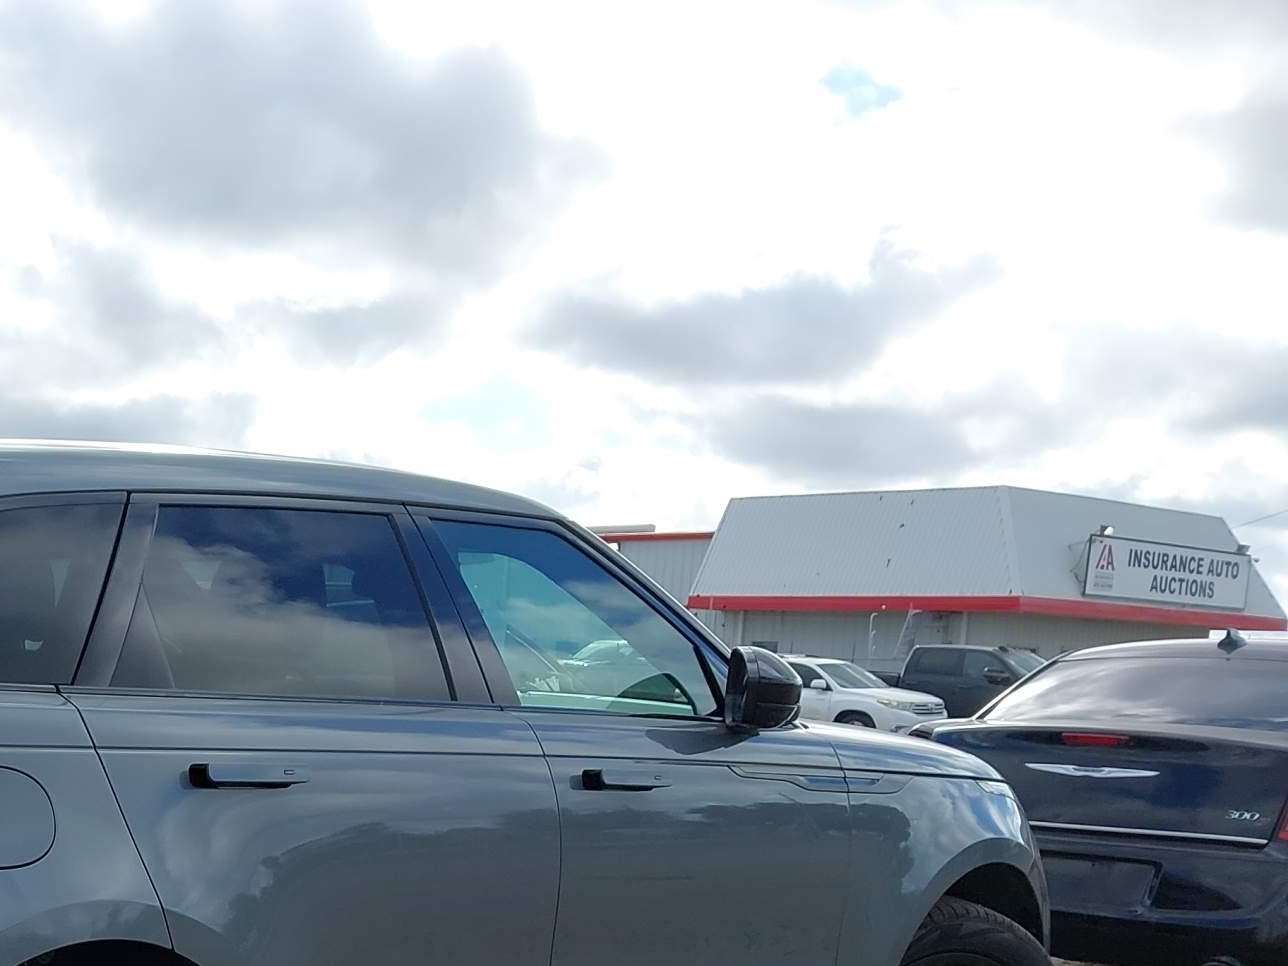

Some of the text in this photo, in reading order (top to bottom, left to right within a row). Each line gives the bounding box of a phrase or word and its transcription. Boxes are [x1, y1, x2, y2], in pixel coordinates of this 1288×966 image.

[1128, 548, 1240, 580] INSURANCE AUTO
[1150, 574, 1215, 599] AUCTIONS
